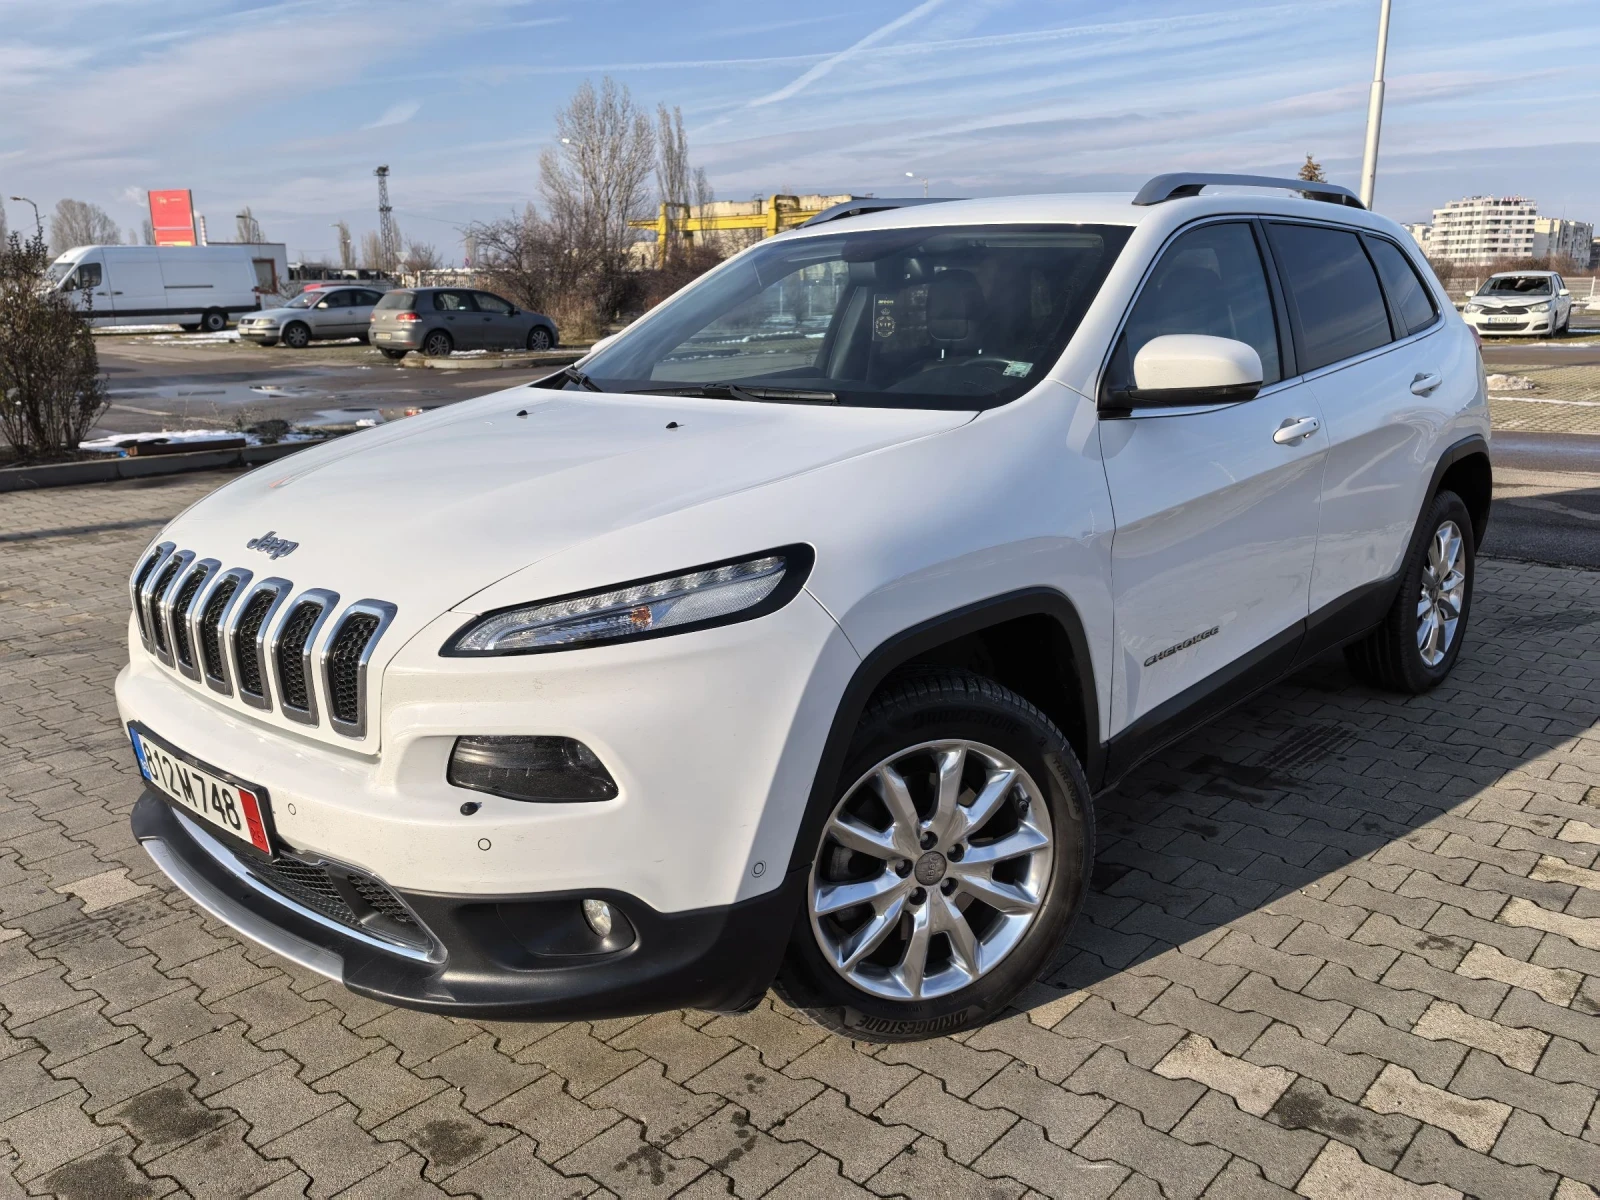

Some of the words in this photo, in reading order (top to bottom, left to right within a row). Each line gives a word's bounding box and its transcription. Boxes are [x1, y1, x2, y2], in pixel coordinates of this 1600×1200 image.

[246, 531, 299, 560] Jeep
[1052, 755, 1081, 815] TURANZA
[855, 1009, 969, 1035] BRIDGESTONE
